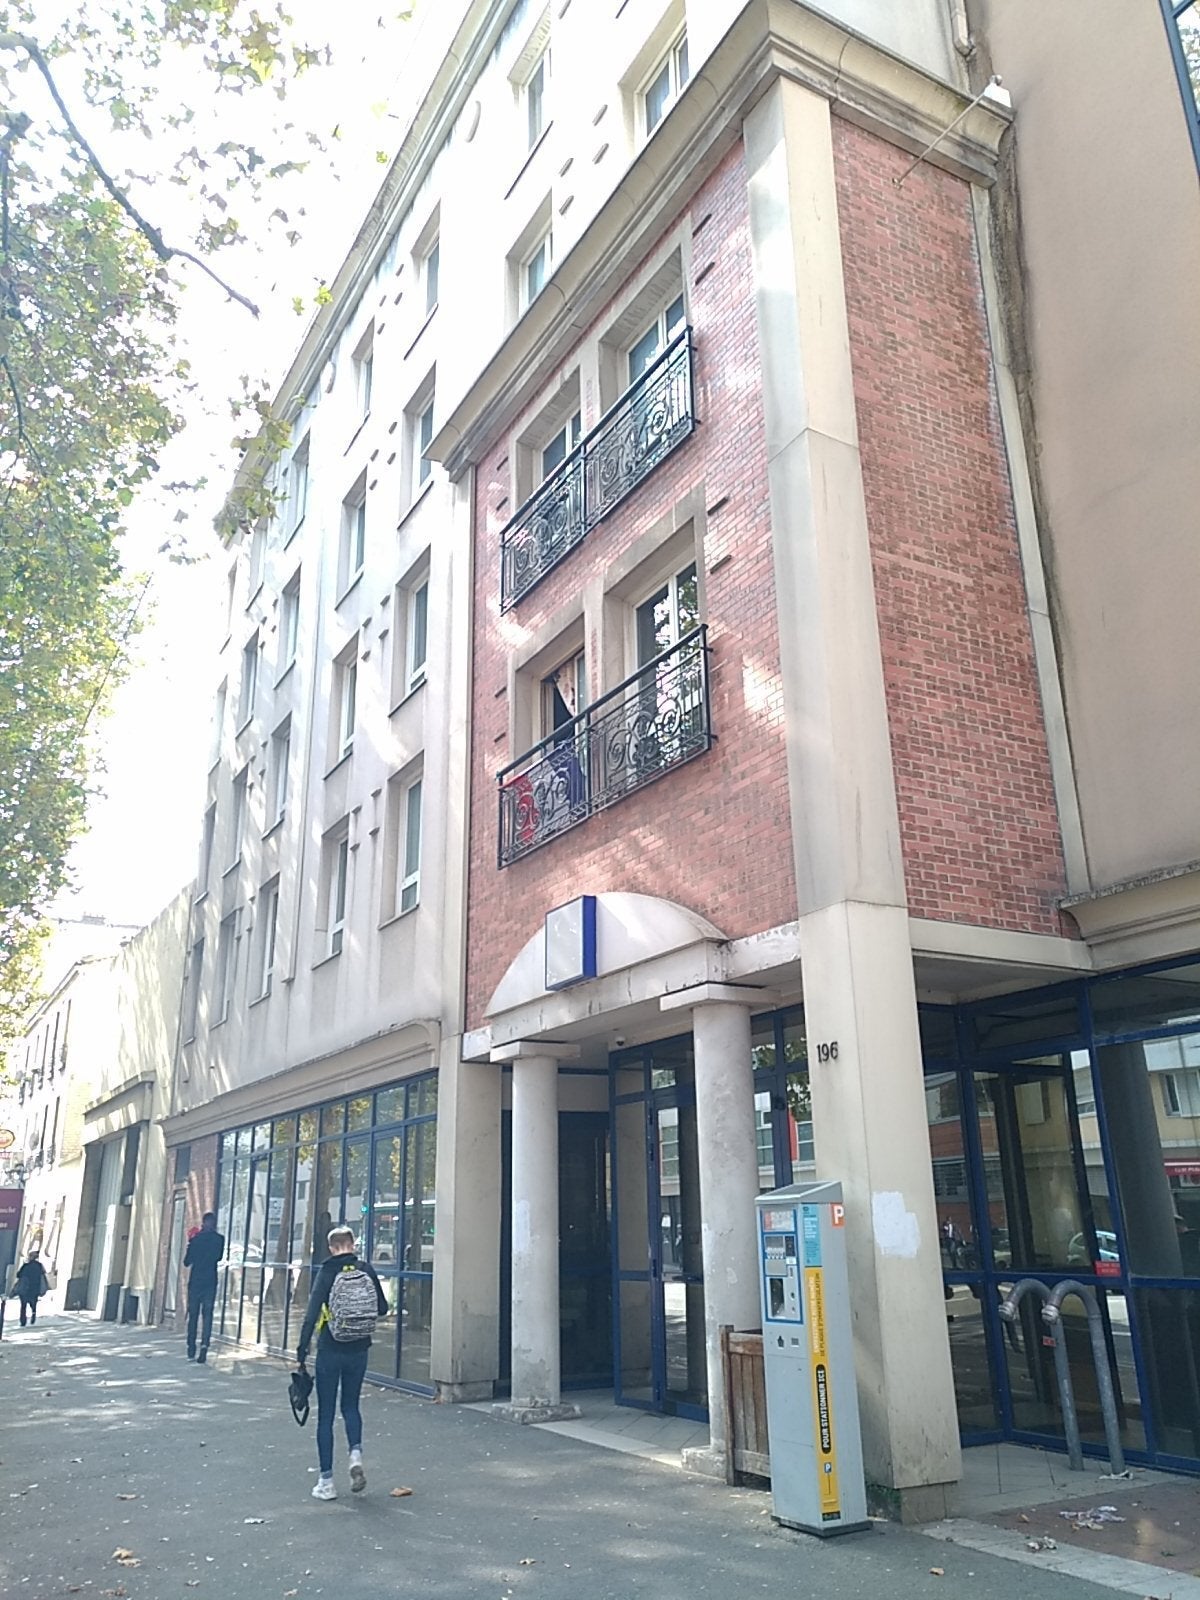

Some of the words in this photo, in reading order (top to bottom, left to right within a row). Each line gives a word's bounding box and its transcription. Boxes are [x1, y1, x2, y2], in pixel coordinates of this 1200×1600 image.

[816, 1041, 838, 1063] 196
[833, 1205, 845, 1225] P
[817, 1370, 825, 1382] ICI
[818, 1383, 828, 1427] STATIONNER
[822, 1428, 830, 1448] POUR
